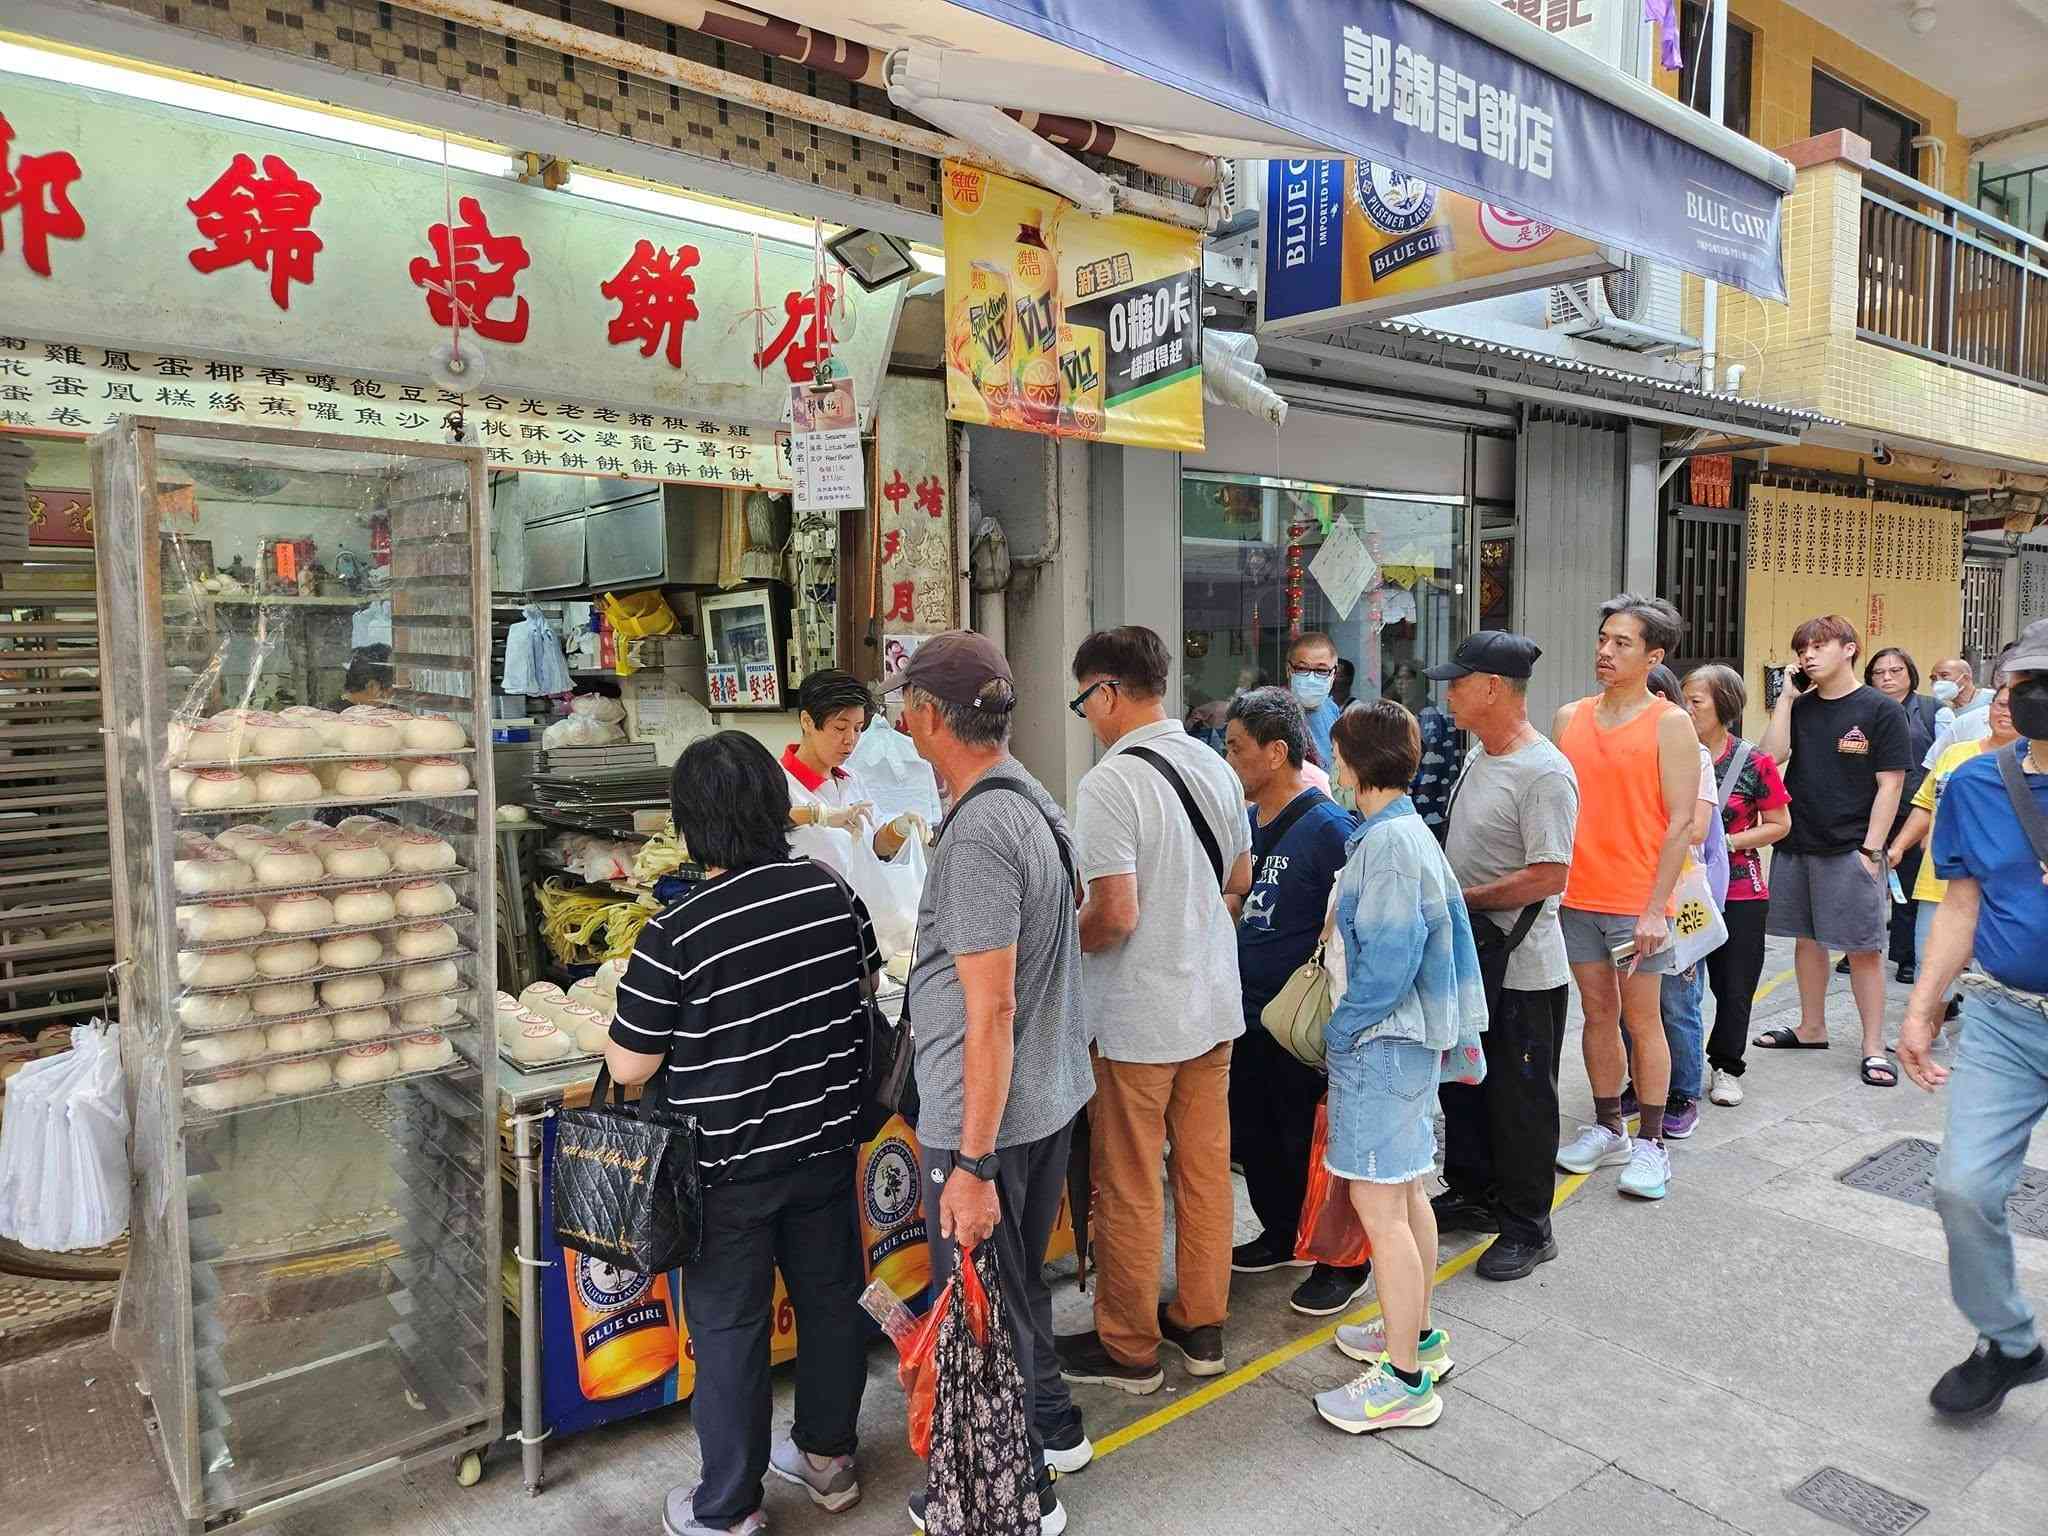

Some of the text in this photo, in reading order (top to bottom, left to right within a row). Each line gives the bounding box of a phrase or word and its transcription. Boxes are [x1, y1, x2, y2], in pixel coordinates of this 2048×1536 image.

[1343, 25, 1553, 180] 郭錦記餅店
[1286, 180, 1307, 269] BLUE
[1320, 188, 1329, 246] IMPORTED
[1367, 197, 1405, 229] PILSENER
[1686, 191, 1729, 232] BLUE
[1075, 252, 1134, 298] 新登場
[1374, 243, 1416, 275] BLUE
[1109, 281, 1192, 353] 0糖0卡
[45, 343, 92, 427] 雞蛋卷
[255, 367, 297, 417] 香蕉
[395, 384, 430, 429] 豆沙
[518, 398, 552, 465] 光酥餅
[556, 402, 588, 469] 老公餅
[592, 407, 624, 472] 老婆餅
[726, 422, 754, 483] 雞仔餅
[873, 1235, 900, 1261] BLUE
[584, 1280, 616, 1304] PILSENER
[586, 1307, 662, 1347] BLUE GIRL
